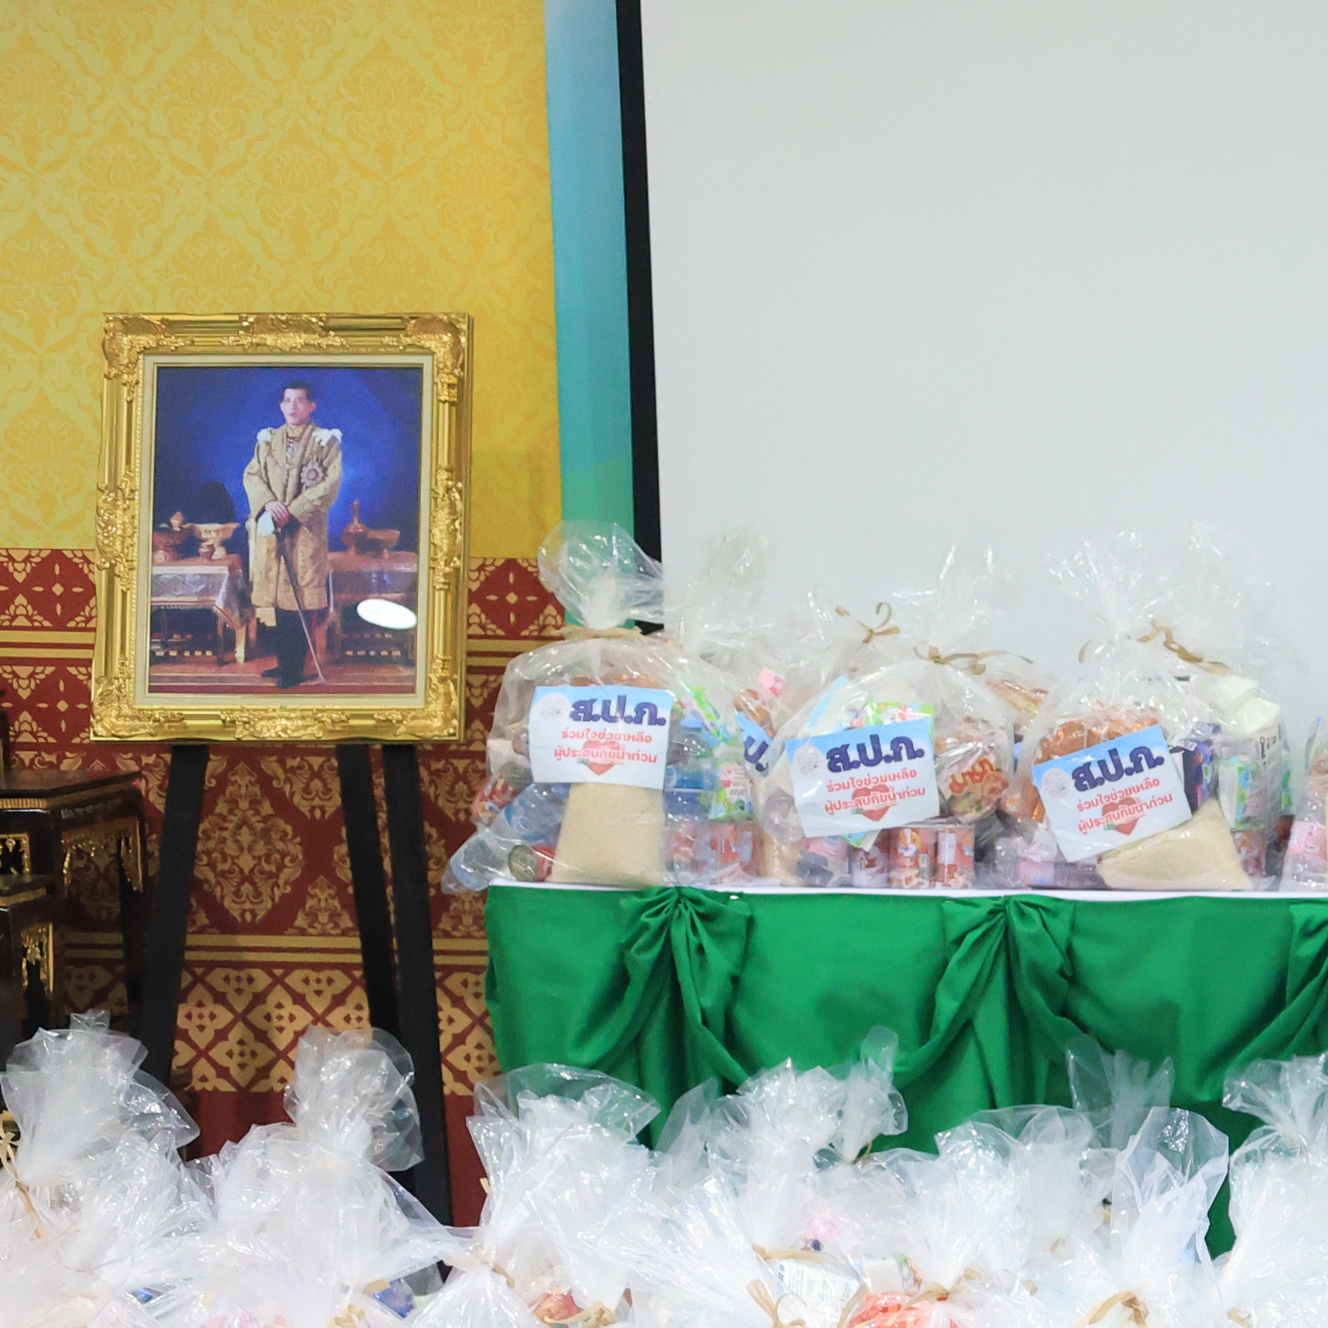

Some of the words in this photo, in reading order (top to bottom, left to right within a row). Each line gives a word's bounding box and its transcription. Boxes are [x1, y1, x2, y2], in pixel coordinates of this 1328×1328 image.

[569, 694, 667, 726] ส.ป.ก.
[826, 734, 925, 773] ส.ป.ก.
[1071, 745, 1165, 792] ส.ป.ก.
[826, 767, 918, 793] ร่วมใจช่วยเหลือ
[1076, 777, 1161, 812] ร่วมใจช่วยเหลือ
[824, 785, 927, 815] ผู้ประสบภัยน้ำท่วม
[1078, 793, 1173, 835] ผู้ประสบภัยน้ำท่วม
